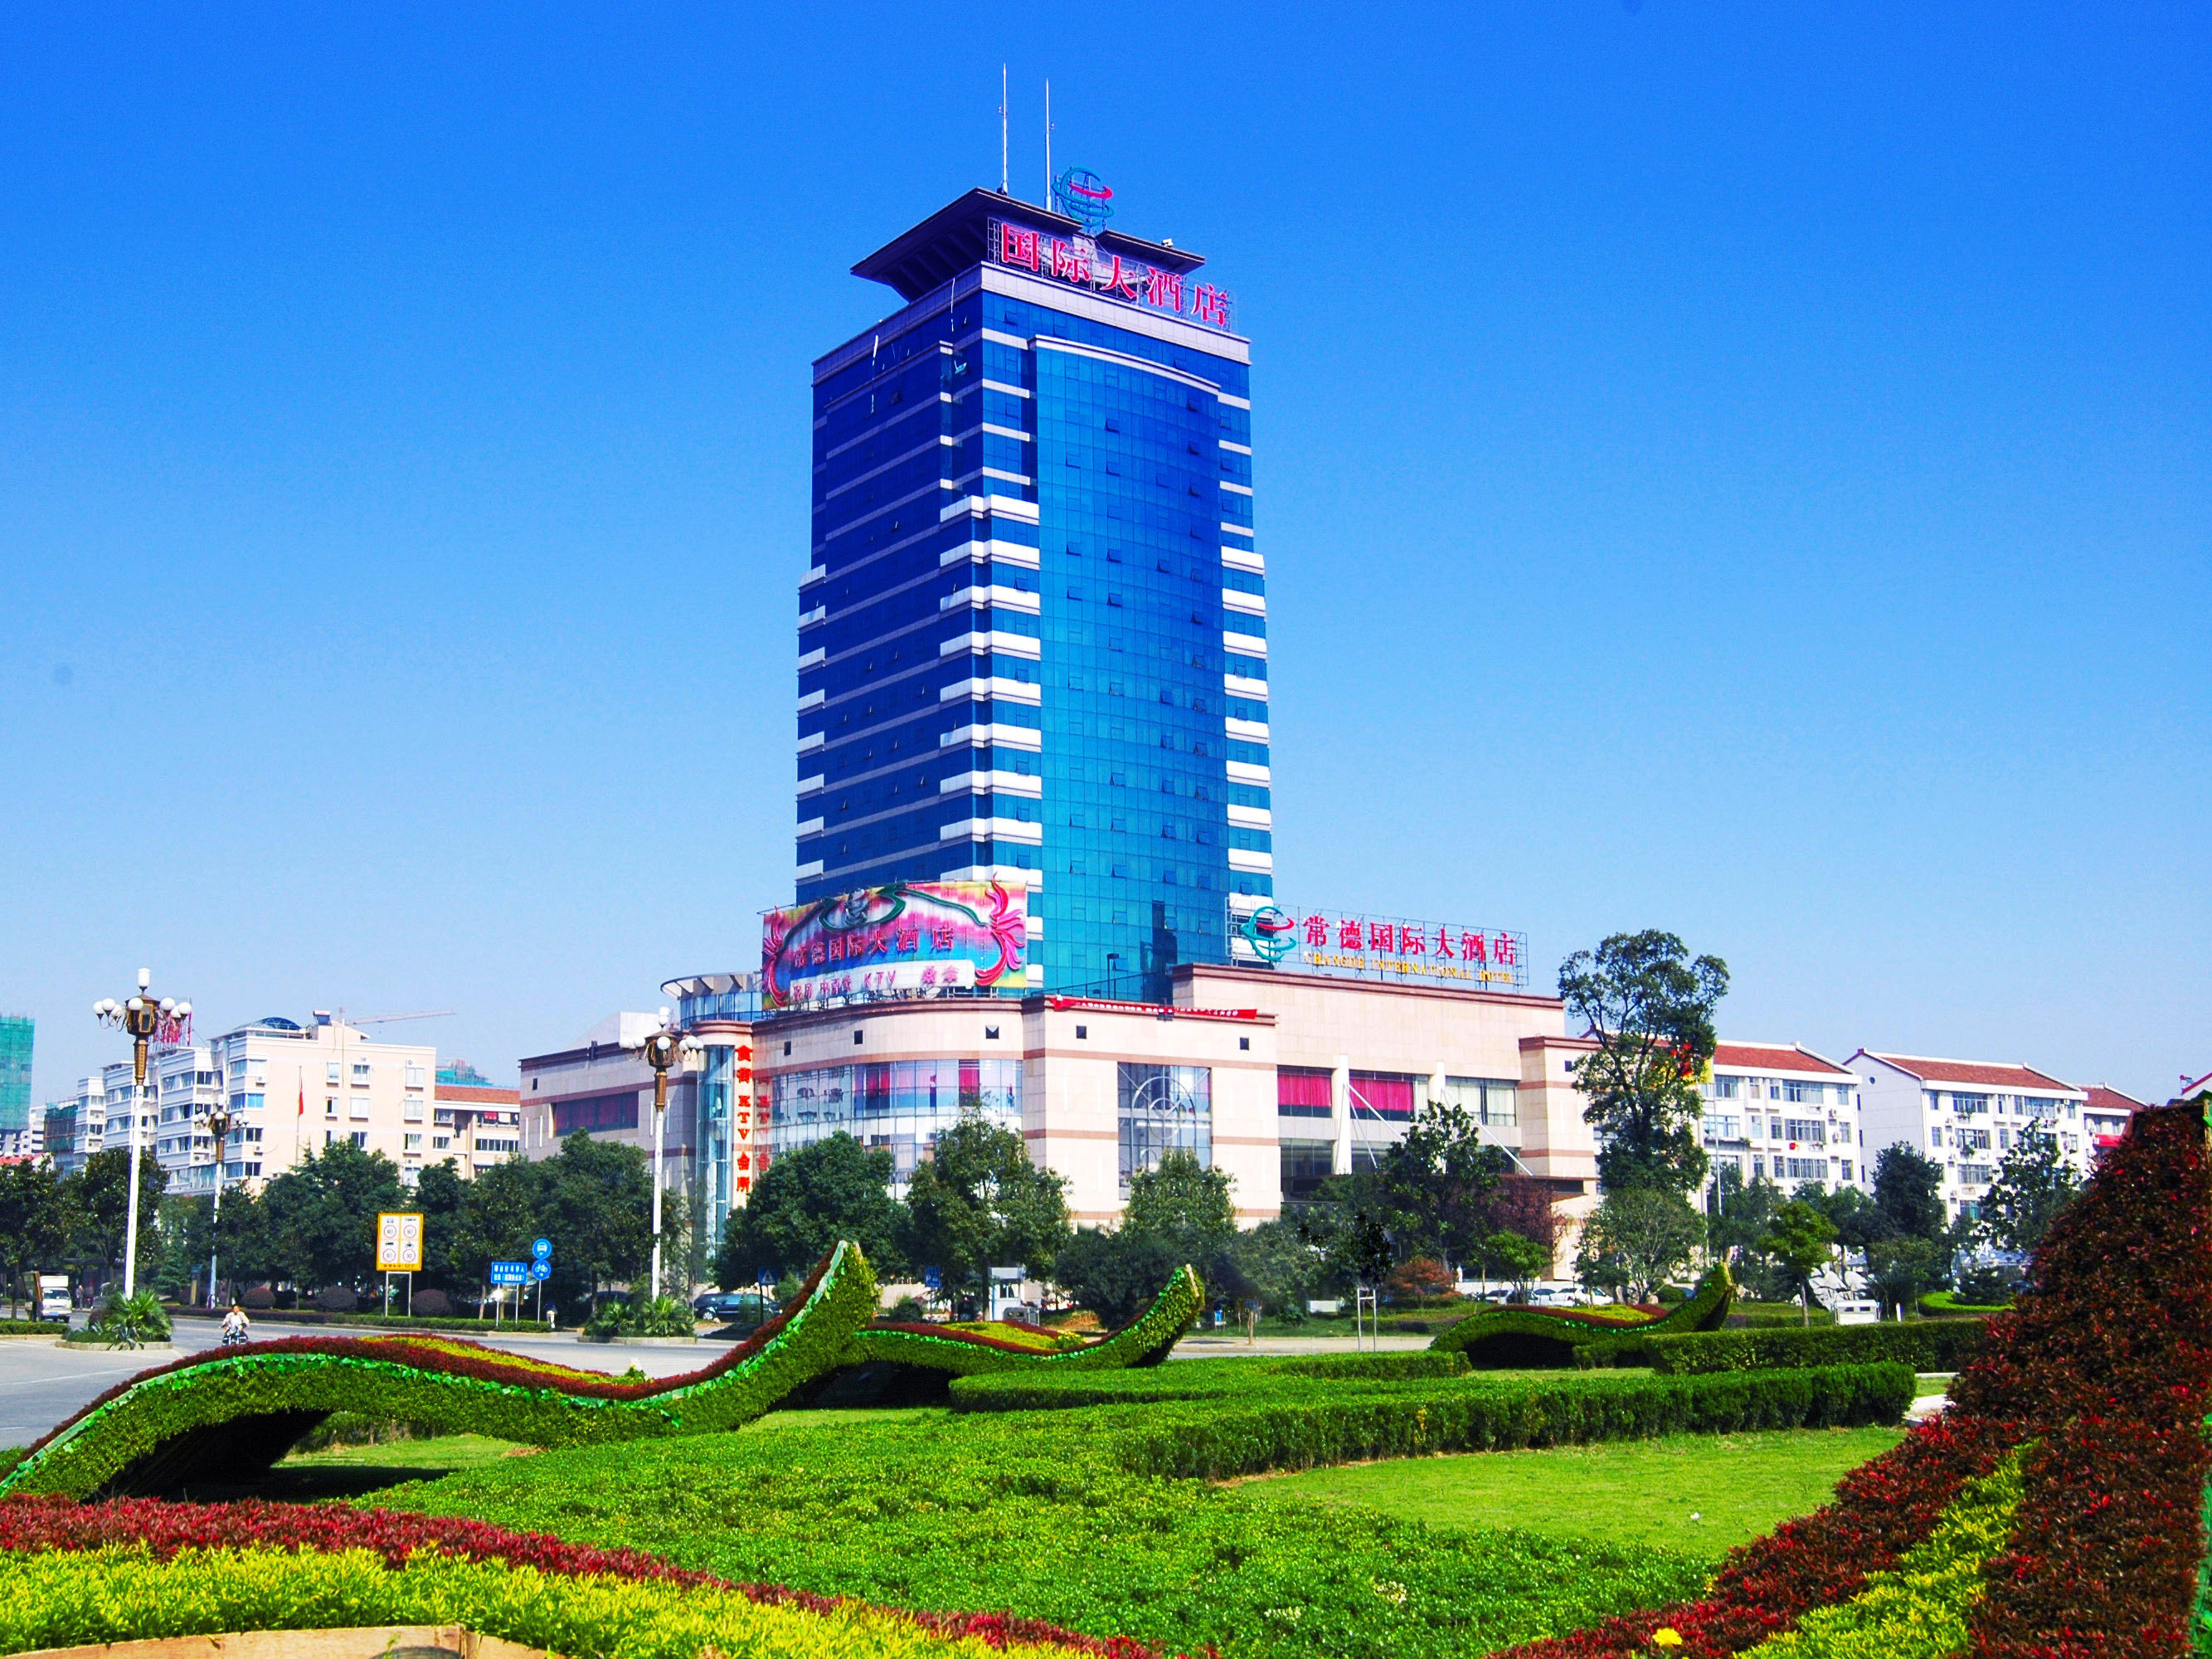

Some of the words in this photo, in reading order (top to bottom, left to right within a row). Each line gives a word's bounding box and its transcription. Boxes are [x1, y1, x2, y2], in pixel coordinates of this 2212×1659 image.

[1000, 222, 1228, 326] 国际大酒店
[793, 926, 955, 968] 常德国际大酒店
[1303, 914, 1516, 966] 常德国际大酒店
[863, 970, 897, 987] KTV
[1371, 958, 1472, 980] INTERNATIONAL
[1478, 970, 1515, 984] HOTEL
[737, 1095, 751, 1140] KTV
